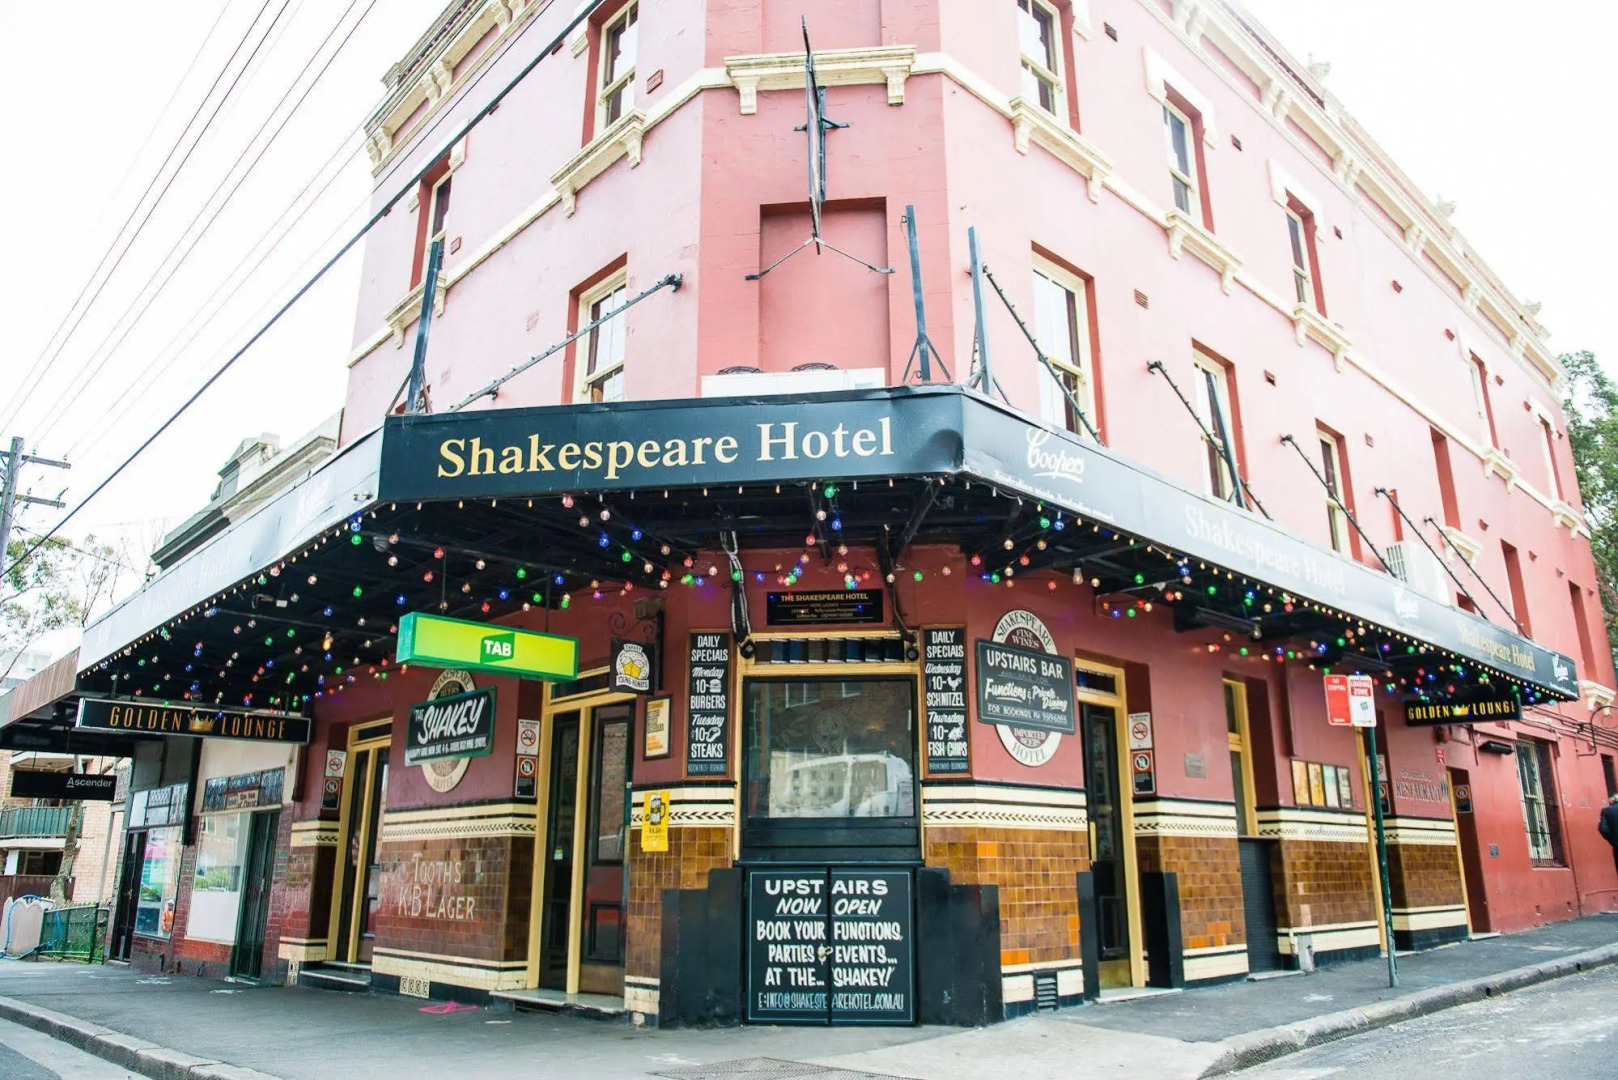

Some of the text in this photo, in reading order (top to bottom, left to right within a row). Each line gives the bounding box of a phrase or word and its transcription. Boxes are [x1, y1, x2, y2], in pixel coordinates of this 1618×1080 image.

[437, 417, 895, 479] Shakespeare Hotel
[1027, 427, 1085, 480] Coopers
[1184, 504, 1300, 574] Shakespeare
[796, 593, 844, 602] SHAKESPEARE
[845, 592, 869, 600] HOTEL
[996, 610, 1054, 648] SHAKESPEARE
[1016, 628, 1033, 639] FINE
[697, 635, 721, 648] DAILY
[931, 631, 955, 644] DAILY
[1011, 634, 1040, 649] WINES
[483, 639, 512, 657] TAB
[691, 649, 729, 662] SPECIALS
[926, 645, 965, 659] SPECIALS
[925, 662, 962, 675] Wednesday
[986, 649, 1064, 680] UPSTAIRS BAR
[692, 666, 725, 680] Monday
[984, 677, 1027, 701] Functions
[690, 694, 726, 710] BURGERS
[926, 692, 965, 707] SCHNITZEL
[987, 703, 1000, 714] FOR
[1407, 704, 1450, 721] GOLDEN
[109, 706, 286, 740] GOLDEN LOUNGE
[692, 713, 725, 728] Tuesday
[928, 711, 965, 726] Thursday
[1013, 727, 1046, 740] IMPORTED
[690, 743, 723, 759] STEAKS
[928, 741, 968, 757] FISH CHIPS
[1012, 742, 1046, 763] HOTEL
[65, 776, 114, 789] Ascender
[412, 852, 462, 884] TOOTH'S
[426, 884, 476, 920] LAGER
[776, 897, 882, 916] NOW OPEN
[756, 920, 791, 941] BOOK
[794, 920, 826, 940] YOUR
[768, 944, 815, 963] PARTIES
[765, 967, 783, 986] AT
